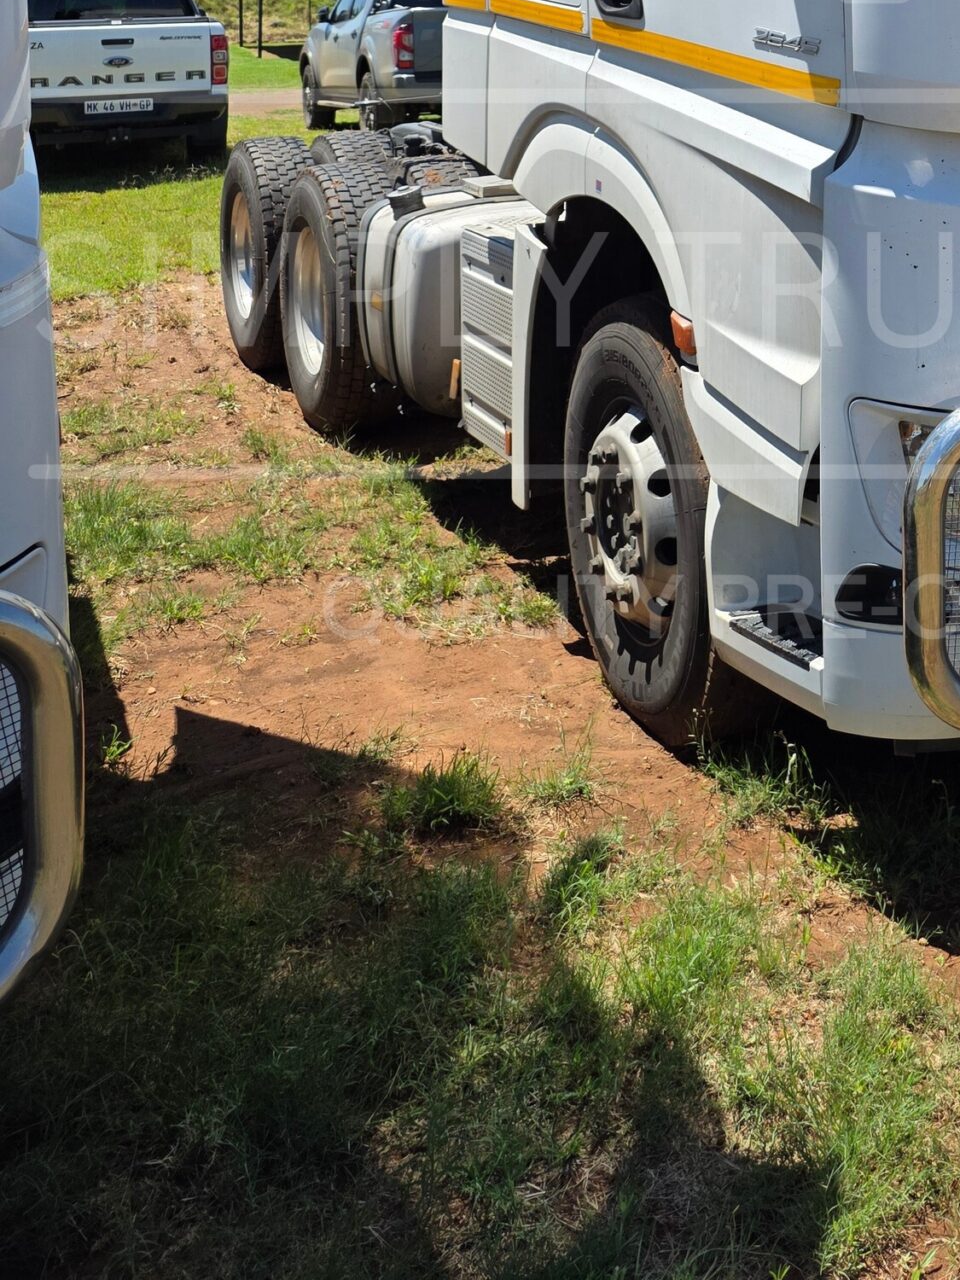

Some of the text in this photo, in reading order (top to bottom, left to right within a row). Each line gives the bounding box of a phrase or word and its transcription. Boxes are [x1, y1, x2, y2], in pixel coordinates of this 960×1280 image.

[30, 70, 207, 88] RANGER
[103, 101, 115, 112] 46
[139, 99, 151, 111] GP
